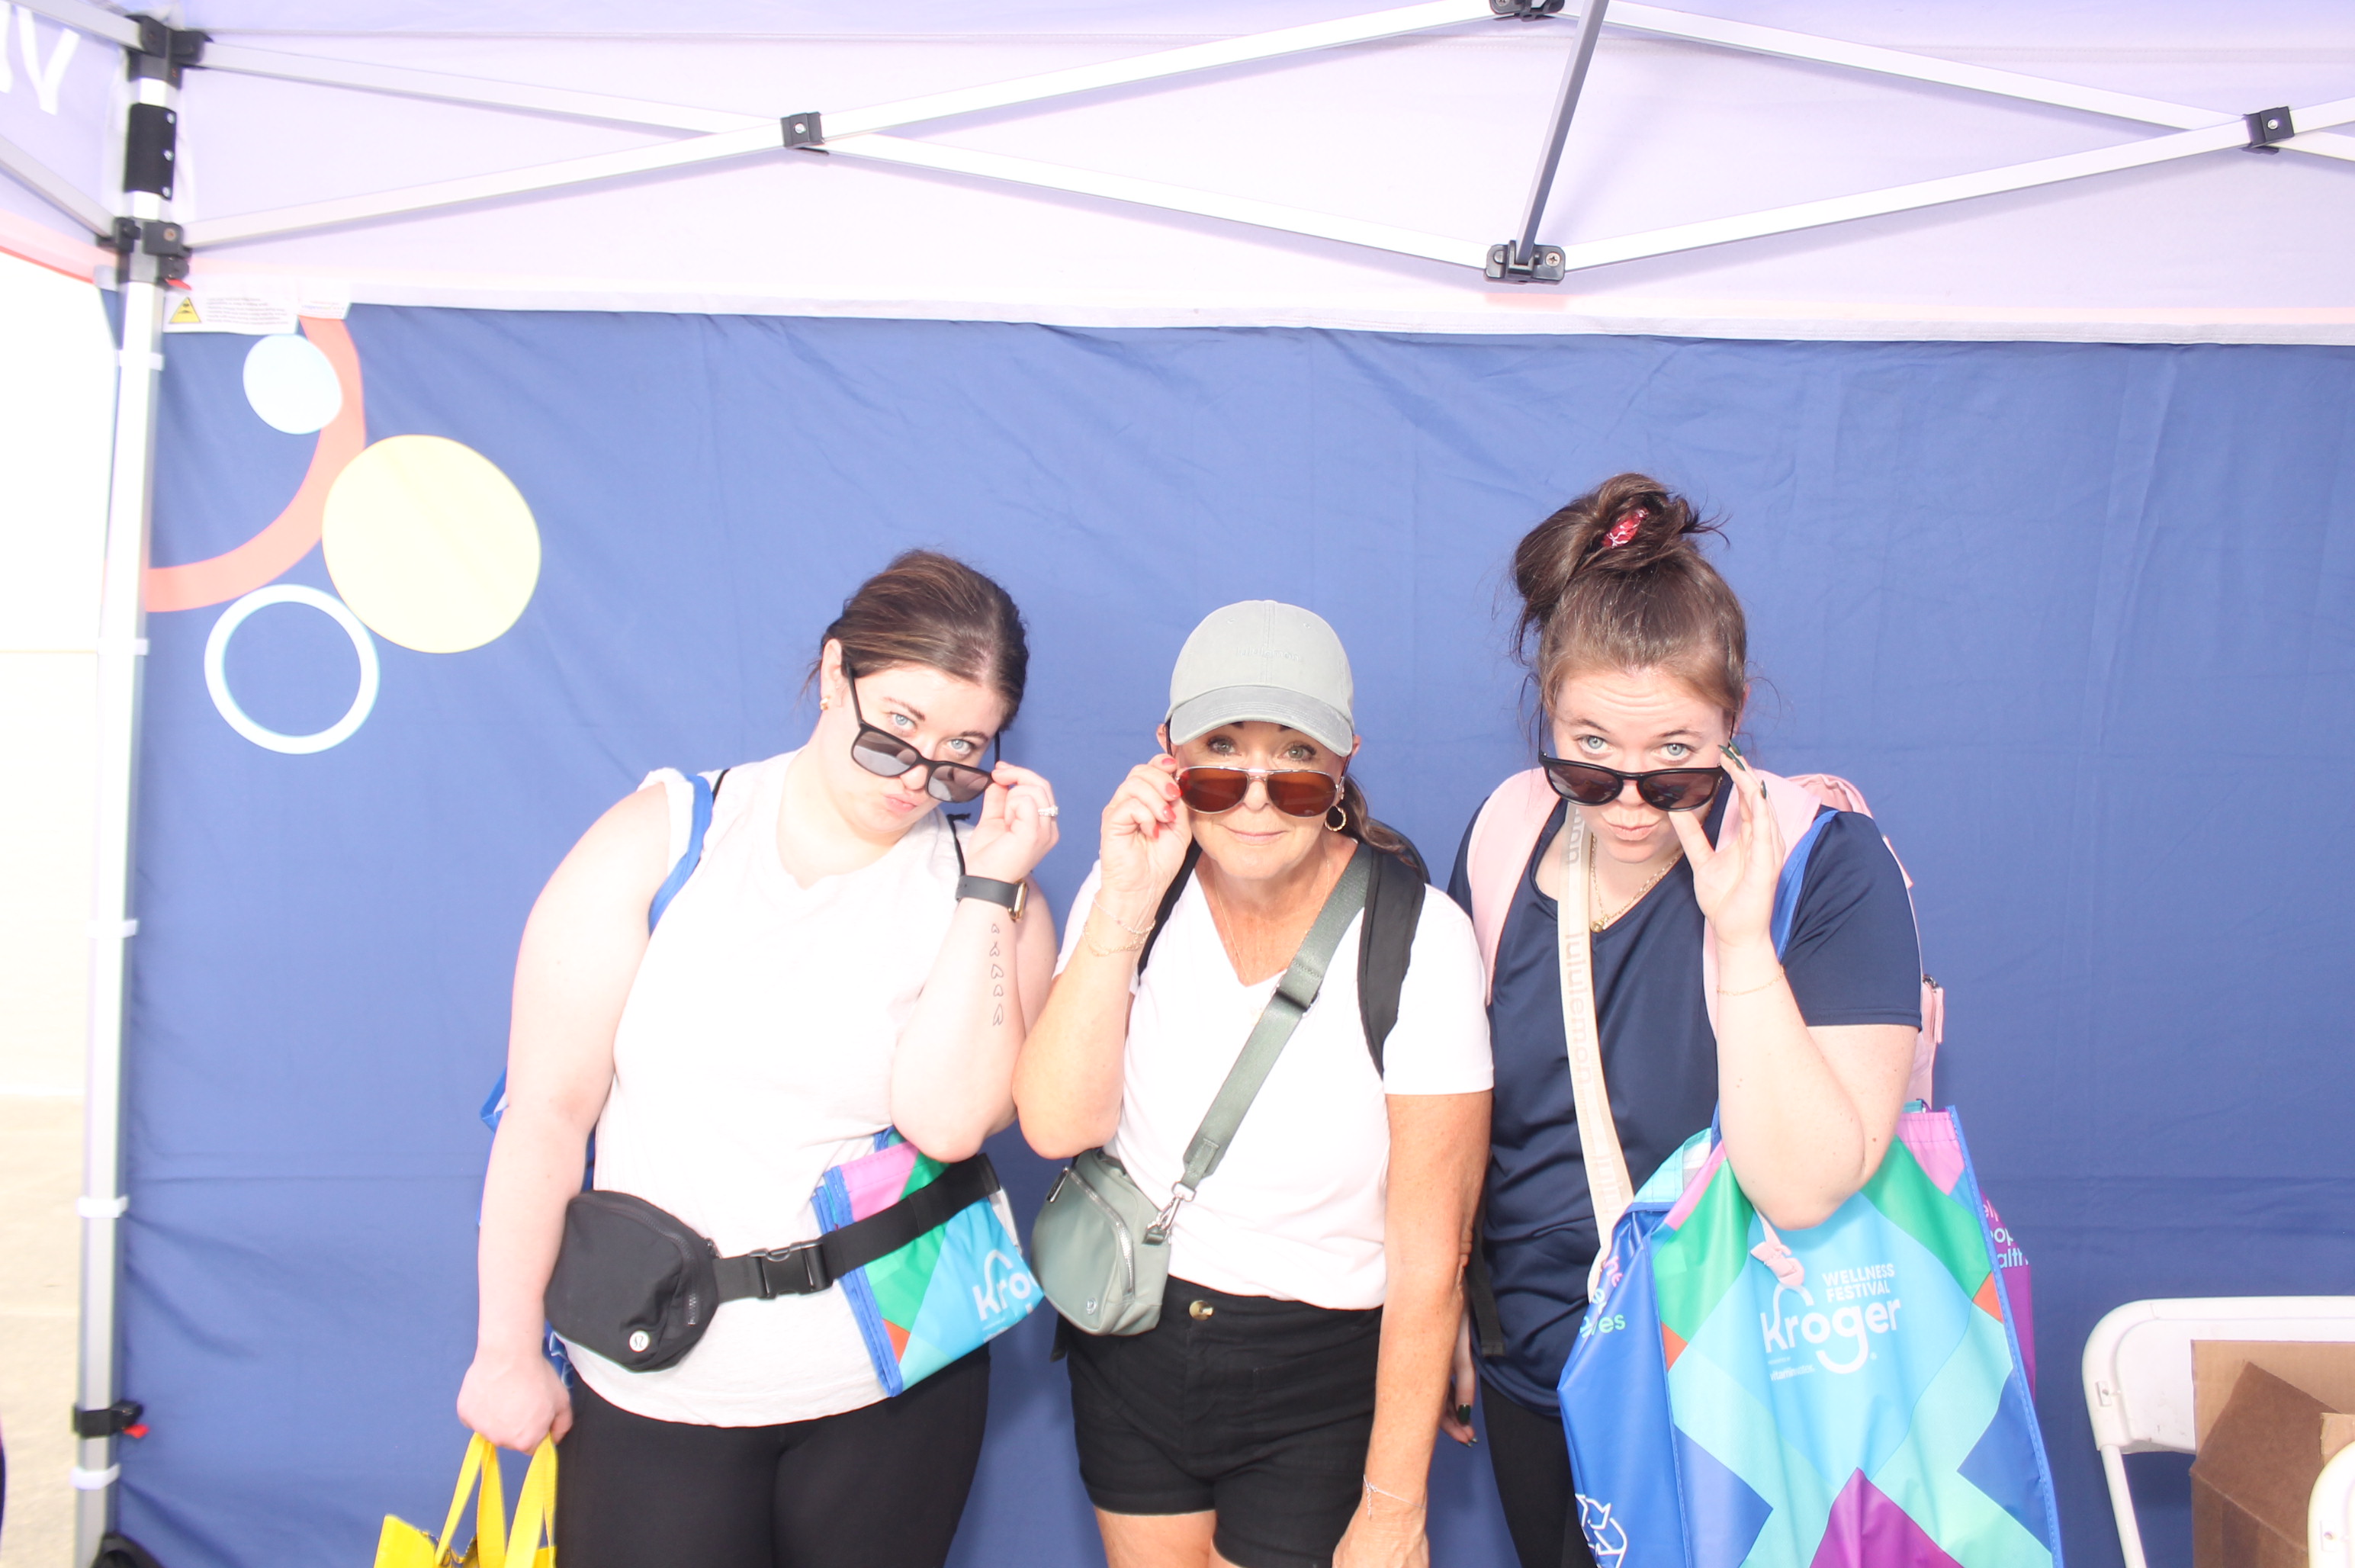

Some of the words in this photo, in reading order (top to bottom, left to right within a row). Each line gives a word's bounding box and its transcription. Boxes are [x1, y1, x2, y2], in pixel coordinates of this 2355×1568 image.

[1235, 646, 1300, 662] lululemon
[1564, 932, 1593, 1086] lululemon
[1822, 1263, 1895, 1287] WELLNESS
[1826, 1280, 1891, 1303] FESTIVAL
